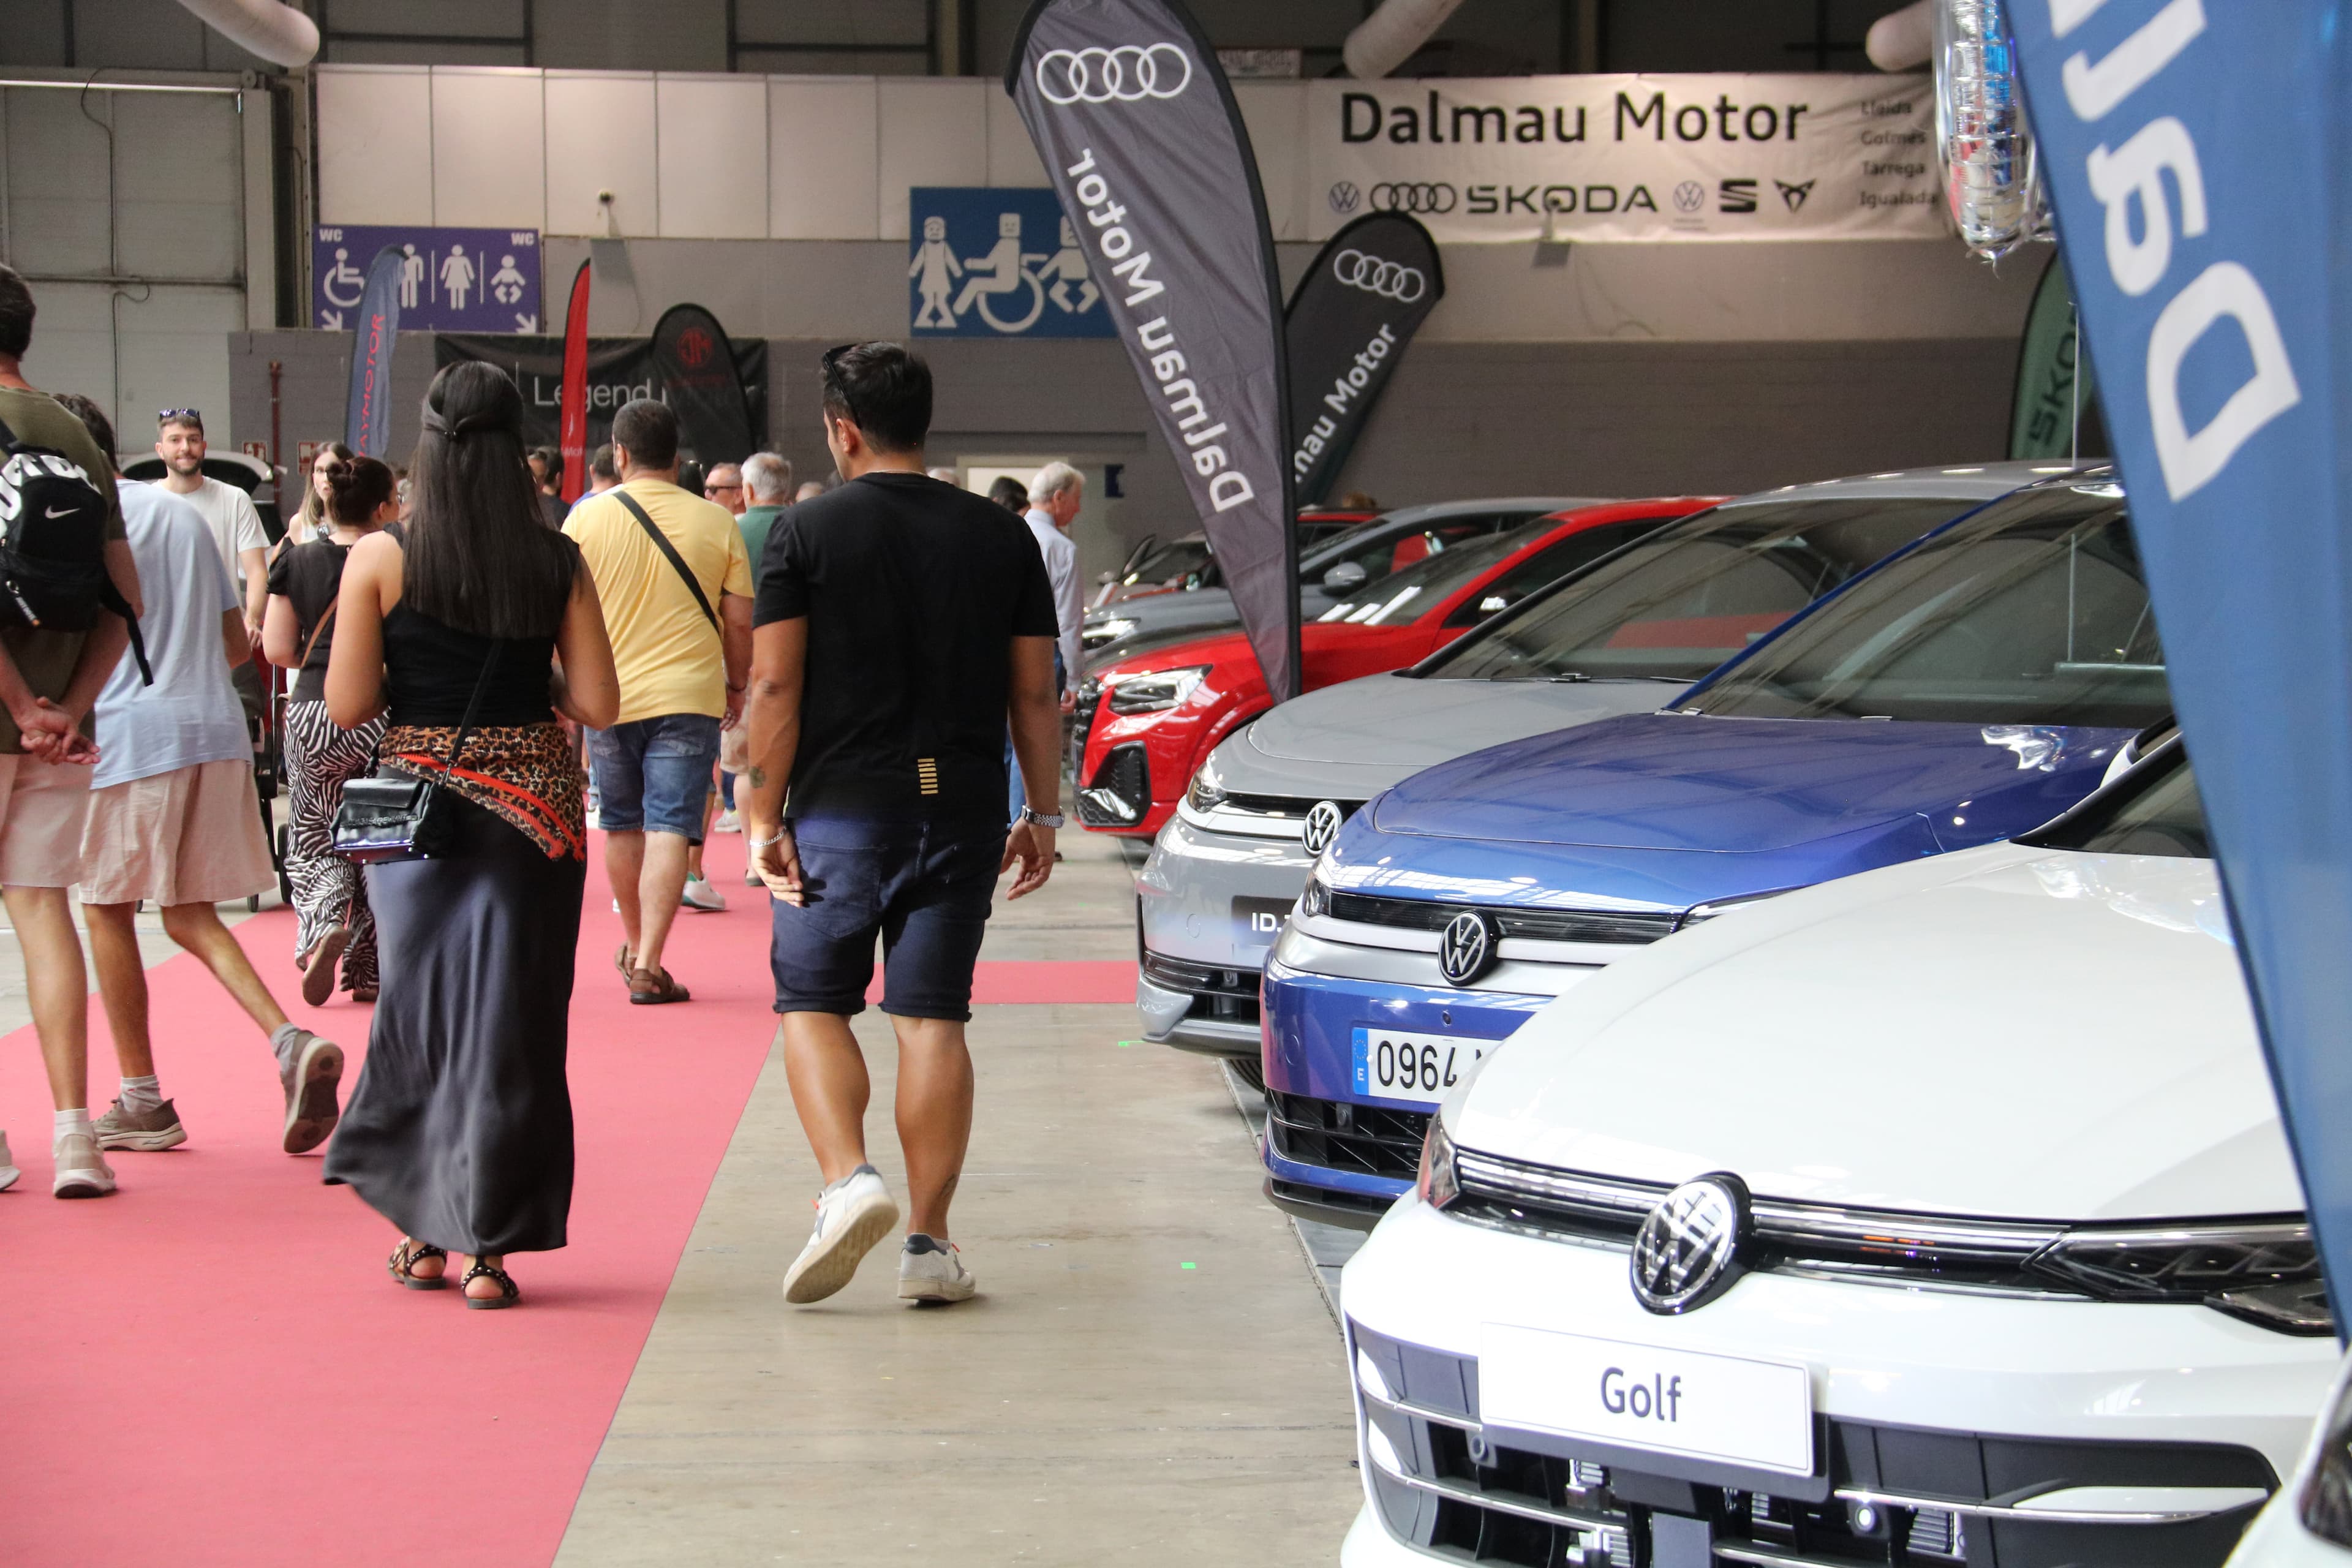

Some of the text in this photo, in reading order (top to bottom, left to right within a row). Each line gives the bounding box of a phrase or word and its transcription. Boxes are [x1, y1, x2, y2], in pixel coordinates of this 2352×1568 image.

[1342, 90, 1809, 144] Dalmau Motor
[319, 228, 343, 242] WC
[511, 232, 534, 246] WC
[1324, 323, 1396, 415] Motor
[2028, 306, 2077, 447] SKO
[1357, 1040, 1457, 1091] E 0964
[1600, 1366, 1681, 1422] Golf
